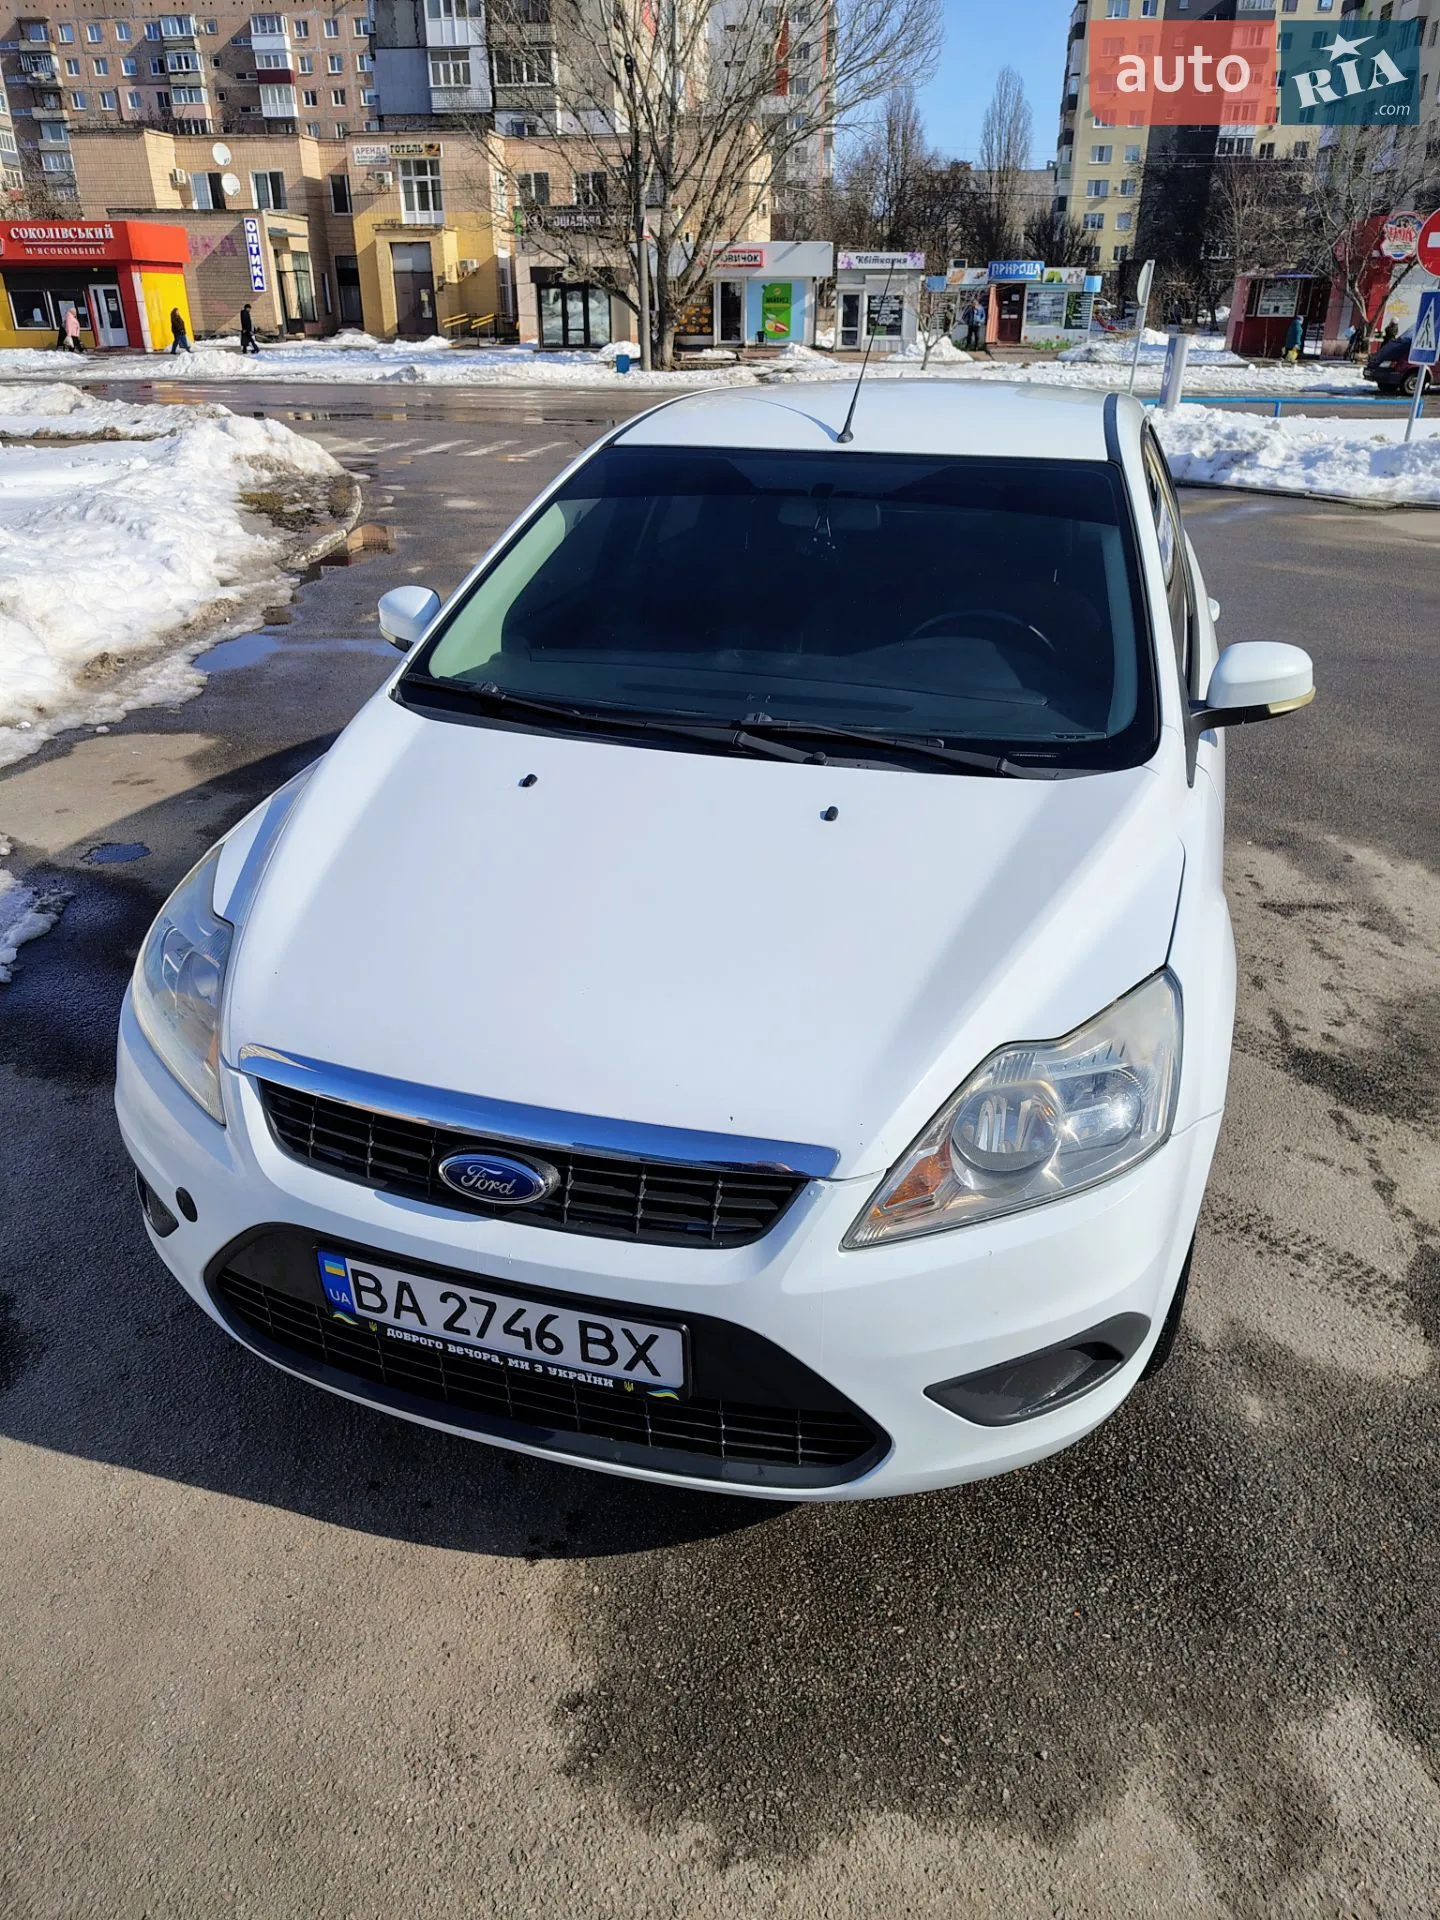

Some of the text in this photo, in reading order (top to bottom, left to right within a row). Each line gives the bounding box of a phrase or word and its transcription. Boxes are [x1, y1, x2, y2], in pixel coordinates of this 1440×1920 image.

[355, 145, 387, 155] АРЕНДА
[389, 143, 423, 153] ГОТЕЛЬ
[10, 223, 115, 240] СОКОЛІВСЬКИЙ
[24, 247, 106, 255] М'ЯСОКОМБІНАТ
[246, 221, 264, 288] ОПТИКА
[991, 262, 1041, 276] ПРИРОДА
[461, 1164, 517, 1195] Ford
[328, 1287, 352, 1305] UA
[350, 1267, 662, 1378] BA 2746 BX
